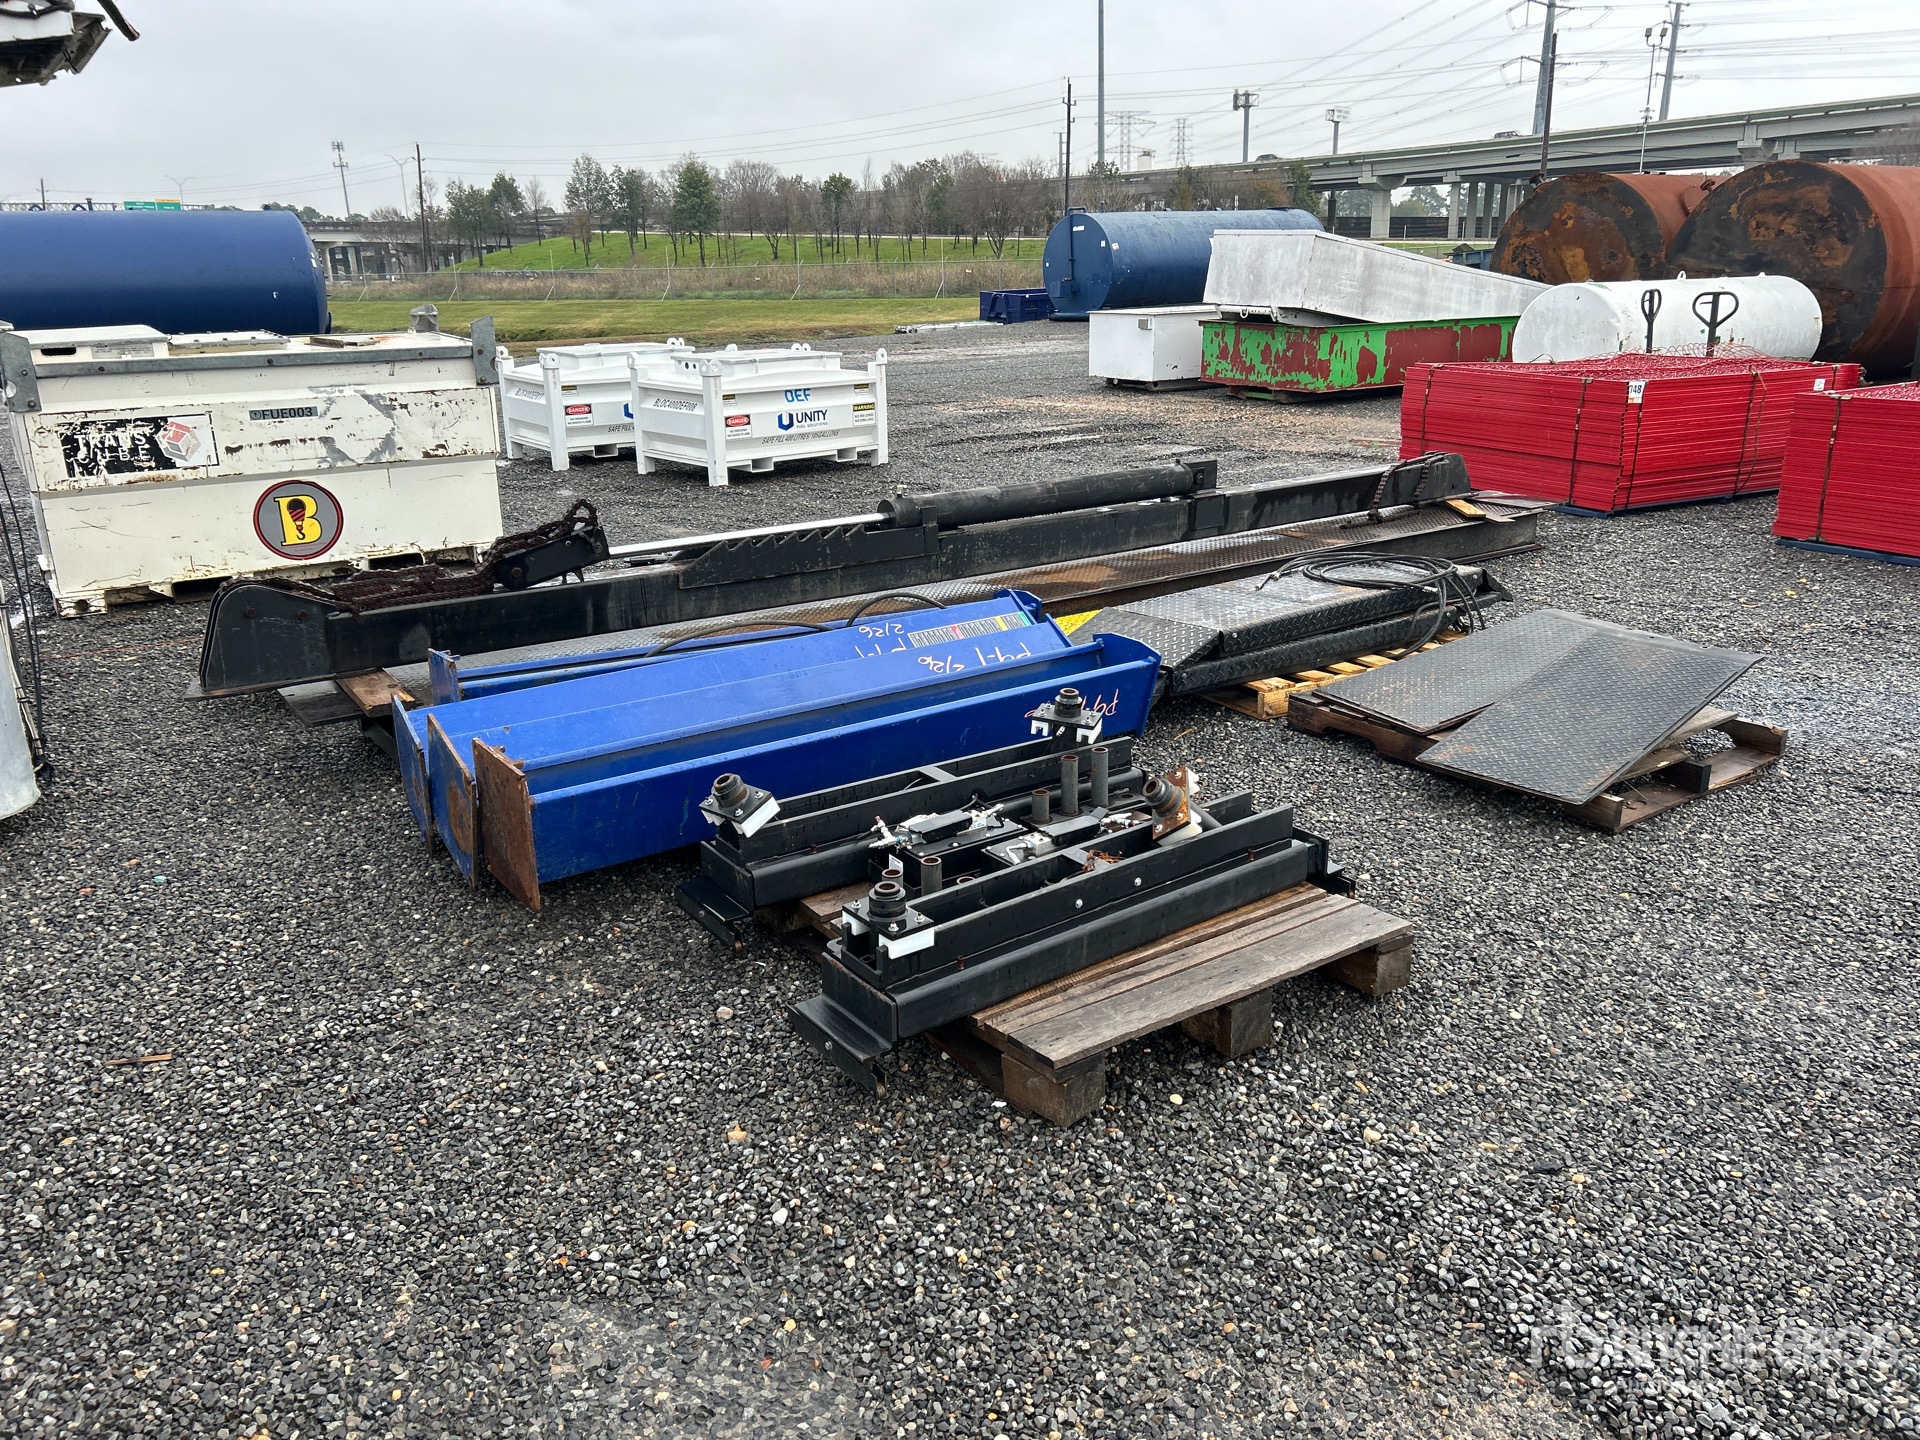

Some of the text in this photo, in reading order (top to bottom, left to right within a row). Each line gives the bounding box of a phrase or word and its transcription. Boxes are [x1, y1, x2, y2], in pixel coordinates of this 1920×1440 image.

[262, 406, 313, 420] FUE003
[796, 409, 828, 423] UNITY
[727, 416, 749, 424] DANGER
[608, 425, 621, 433] SAFE
[761, 436, 774, 444] SAFE
[273, 494, 323, 546] B
